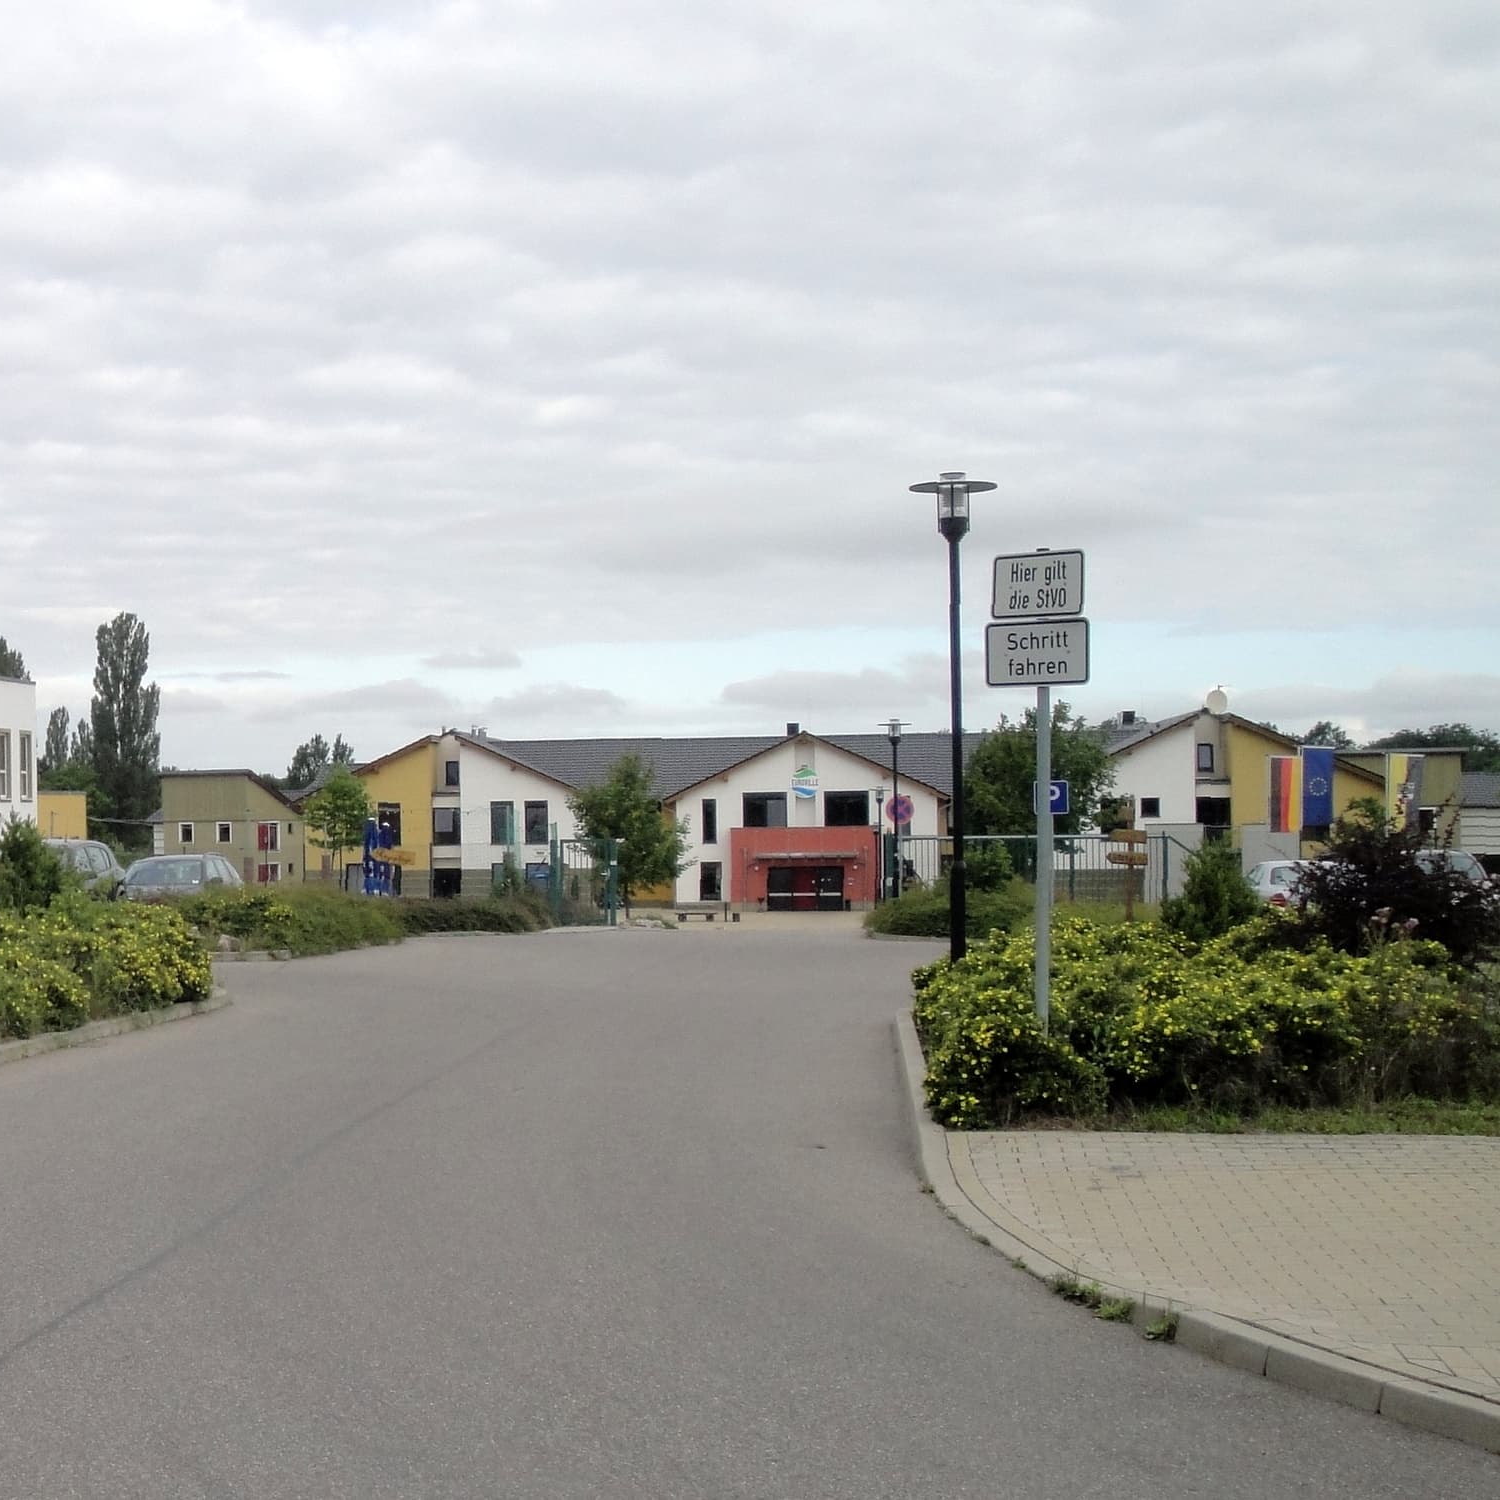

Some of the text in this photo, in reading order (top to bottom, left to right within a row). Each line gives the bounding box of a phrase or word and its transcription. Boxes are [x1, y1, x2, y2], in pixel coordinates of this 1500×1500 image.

[1011, 560, 1067, 586] Hier gilt
[1009, 587, 1067, 610] die StVO
[1007, 631, 1069, 651] Schritt
[1009, 658, 1068, 676] fahren
